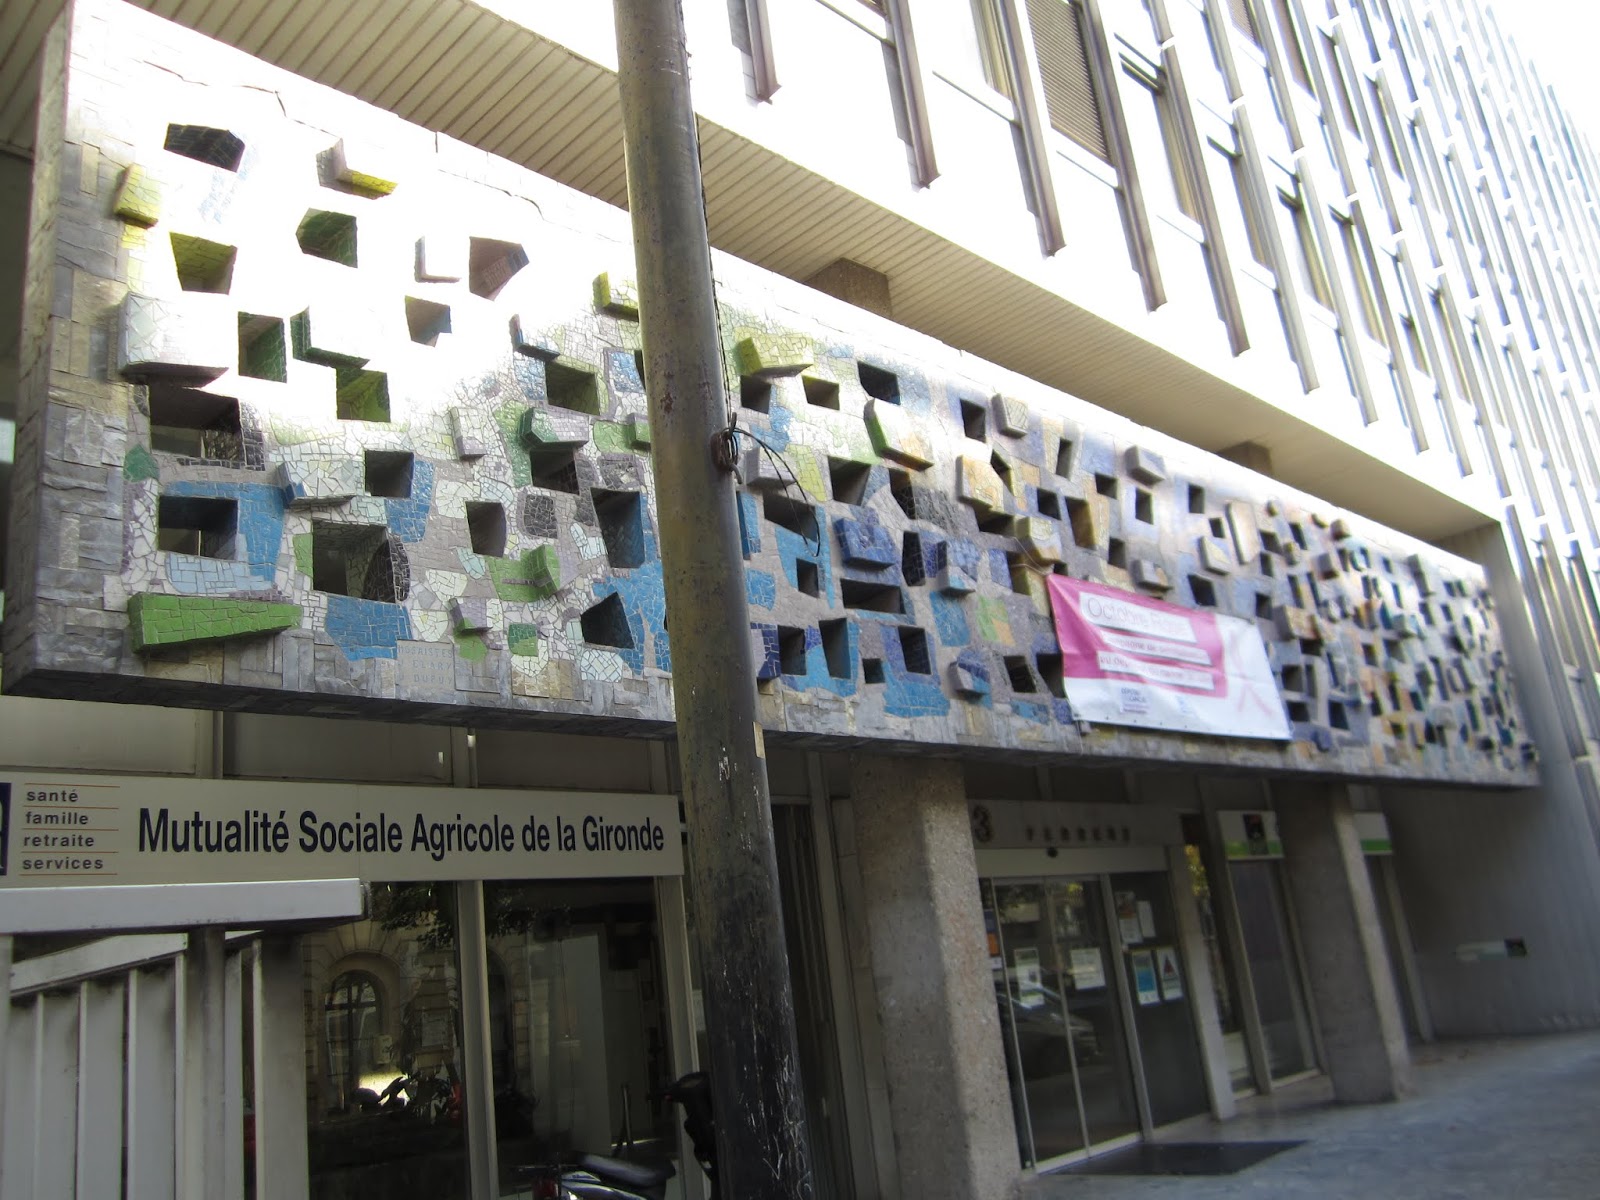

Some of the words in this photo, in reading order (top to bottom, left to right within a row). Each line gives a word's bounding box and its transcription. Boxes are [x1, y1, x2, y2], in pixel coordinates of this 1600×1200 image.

[26, 789, 79, 803] santé
[25, 811, 89, 825] famille
[23, 834, 95, 847] retraite
[138, 808, 290, 854] Mutualité
[298, 810, 403, 853] Sociale
[410, 813, 515, 862] Agricole
[521, 815, 551, 852] de
[556, 815, 577, 852] la
[582, 815, 665, 852] Gironde
[22, 856, 104, 870] services
